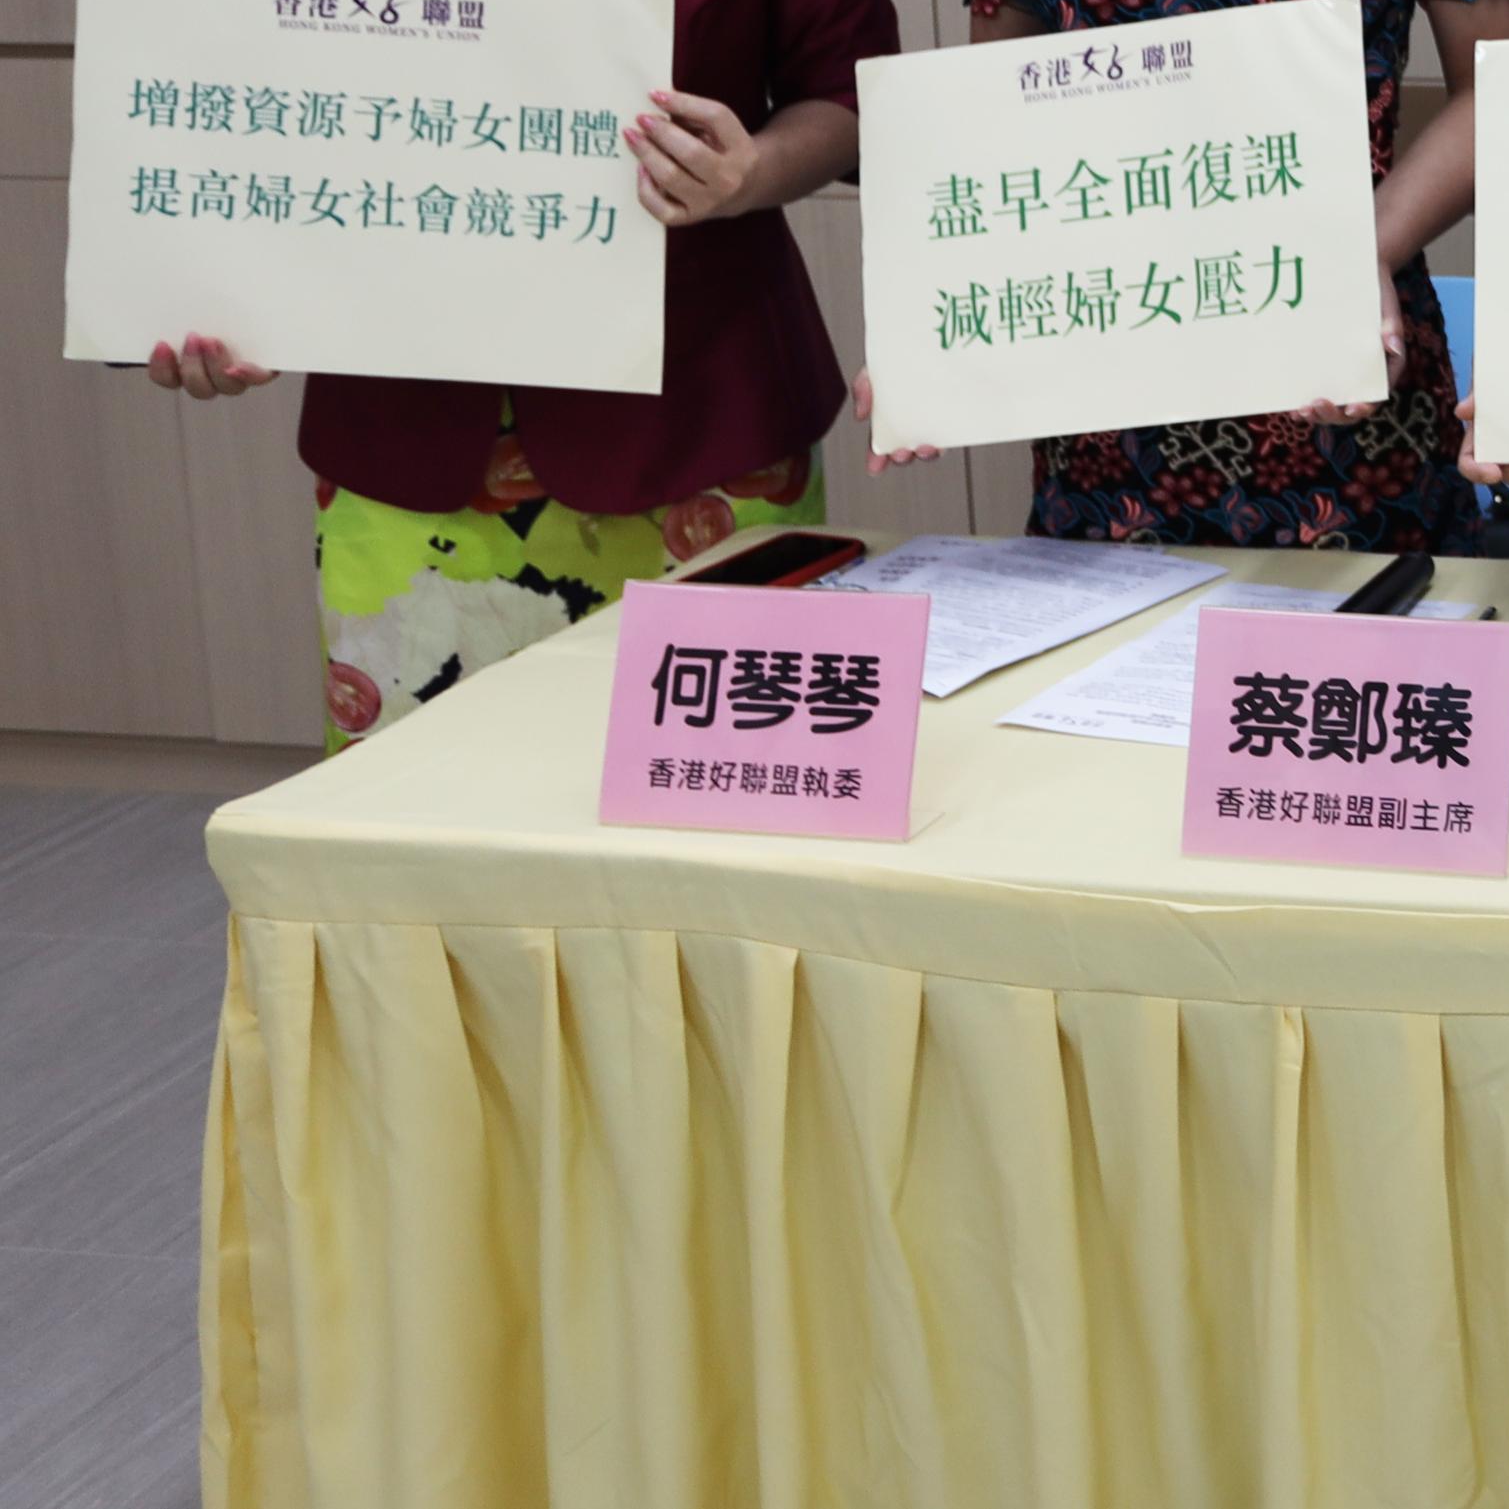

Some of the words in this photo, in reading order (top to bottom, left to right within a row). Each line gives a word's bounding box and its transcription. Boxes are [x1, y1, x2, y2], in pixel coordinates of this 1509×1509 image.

[127, 78, 621, 160] 增撥資源予婦女團體
[128, 168, 618, 245] 提高婦女社會競爭力
[926, 130, 1305, 241] 盡早全面復課
[933, 244, 1306, 351] 減輕婦女壓力
[651, 643, 880, 735] 何琴琴
[1228, 672, 1474, 770] 蔡鄭臻
[648, 757, 864, 801] 香港好聯盟執委
[1215, 787, 1475, 835] 香港好聯盟副主席
